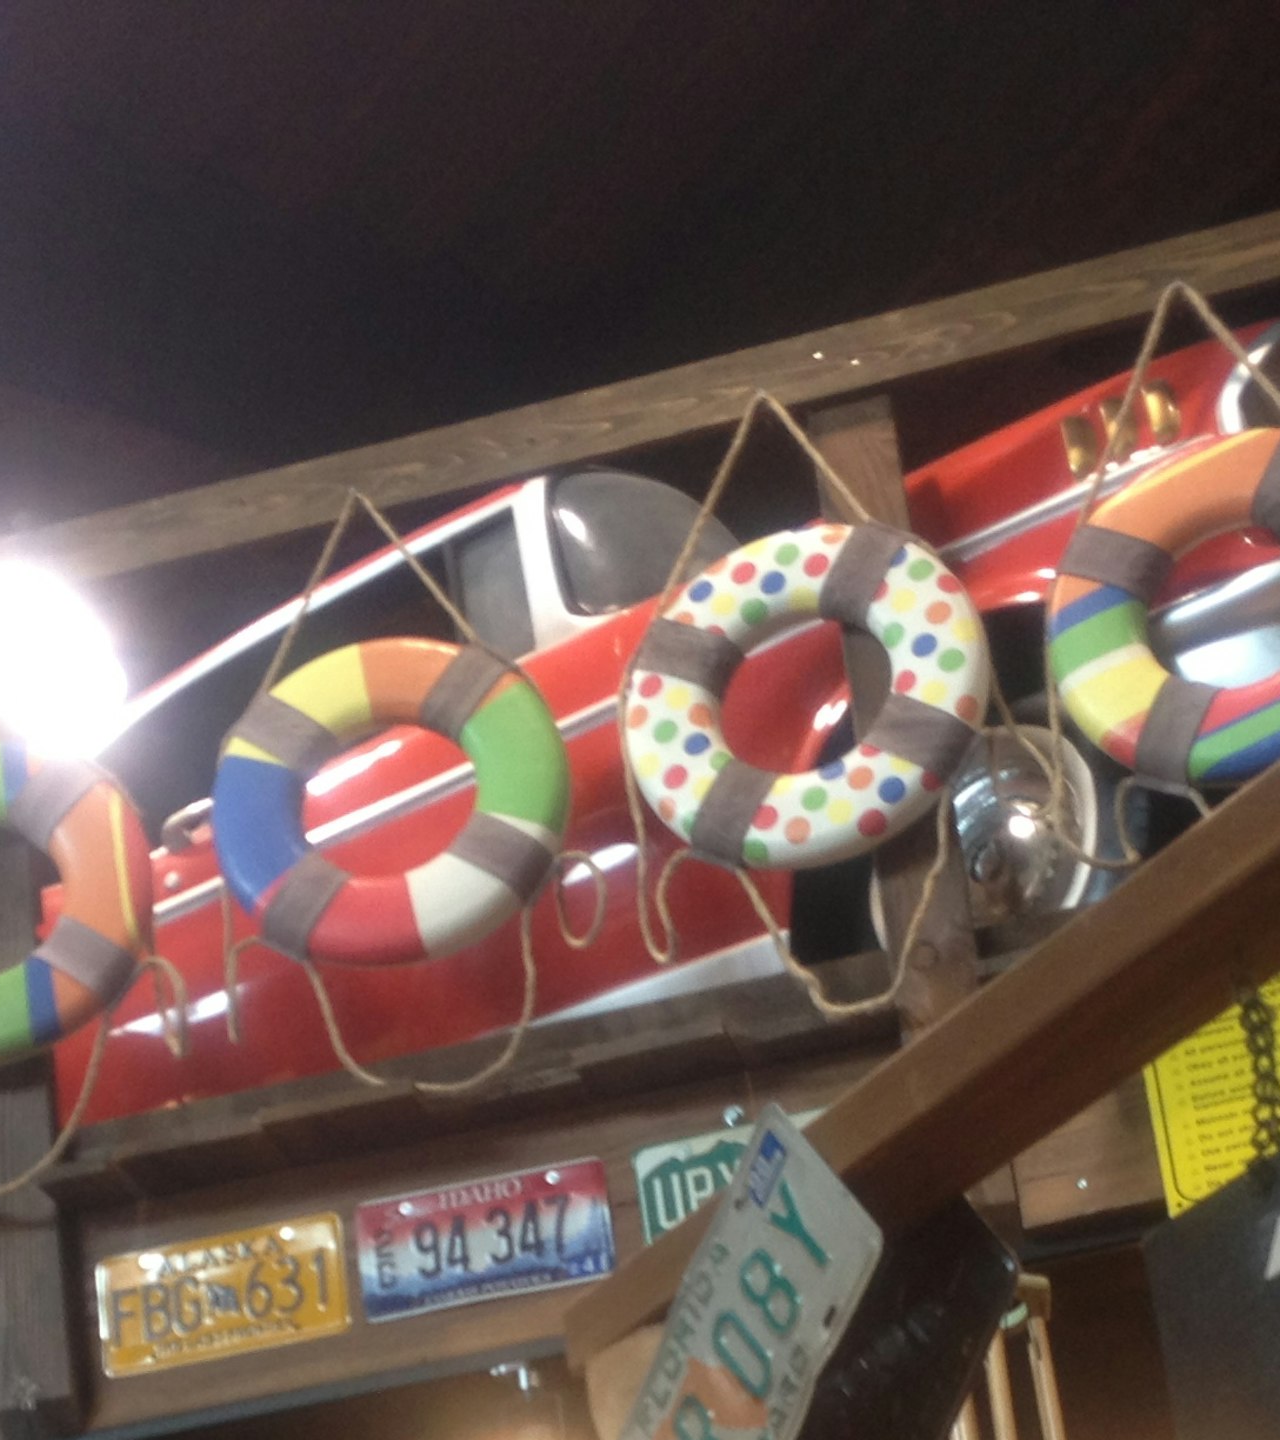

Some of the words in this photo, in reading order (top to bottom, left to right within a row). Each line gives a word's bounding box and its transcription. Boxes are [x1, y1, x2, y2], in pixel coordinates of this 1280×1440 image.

[439, 1177, 523, 1210] IDAHO
[413, 1216, 471, 1281] 94
[486, 1194, 570, 1266] 347
[111, 1274, 203, 1346] FBG
[245, 1248, 329, 1320] 631
